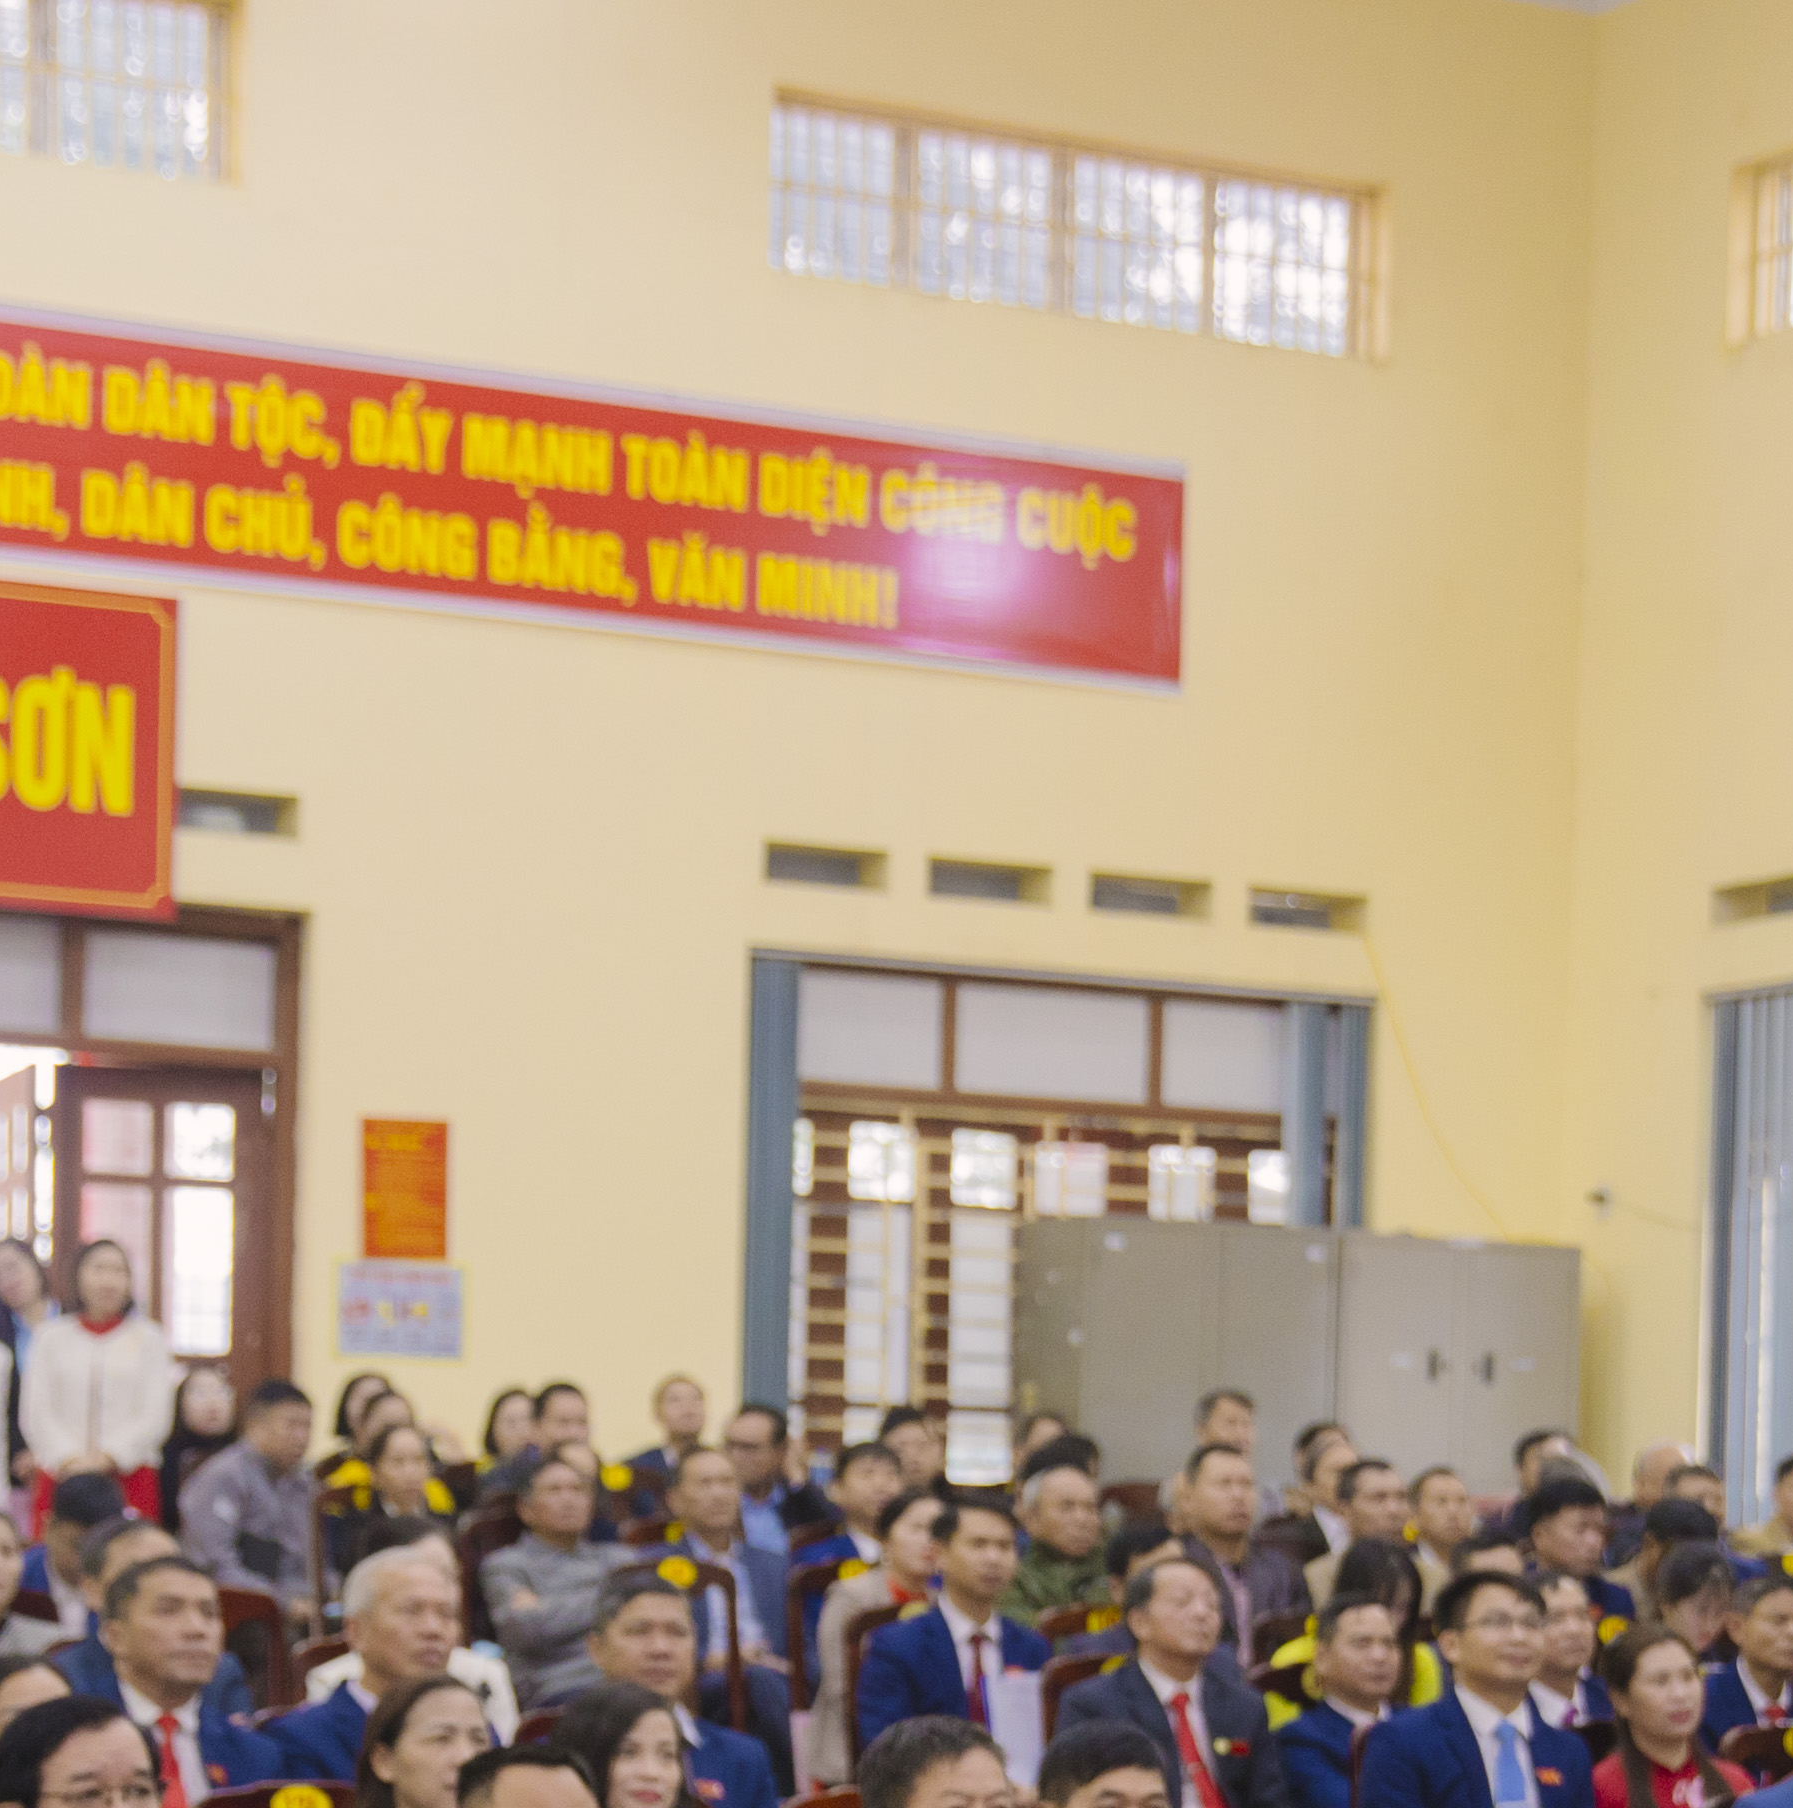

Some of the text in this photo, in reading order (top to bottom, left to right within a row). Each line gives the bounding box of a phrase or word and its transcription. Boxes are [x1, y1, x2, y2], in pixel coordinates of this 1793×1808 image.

[103, 363, 216, 445] DÂN
[225, 377, 341, 467] TỘC,
[349, 385, 454, 474] ĐẨY
[461, 414, 612, 495] MẠNH
[621, 433, 750, 511] TOÀN
[758, 453, 870, 526] DIỆN
[80, 463, 195, 547] DÂN
[204, 480, 326, 568] CHỦ,
[486, 507, 638, 603] BẰNG,
[647, 533, 745, 610] VĂN
